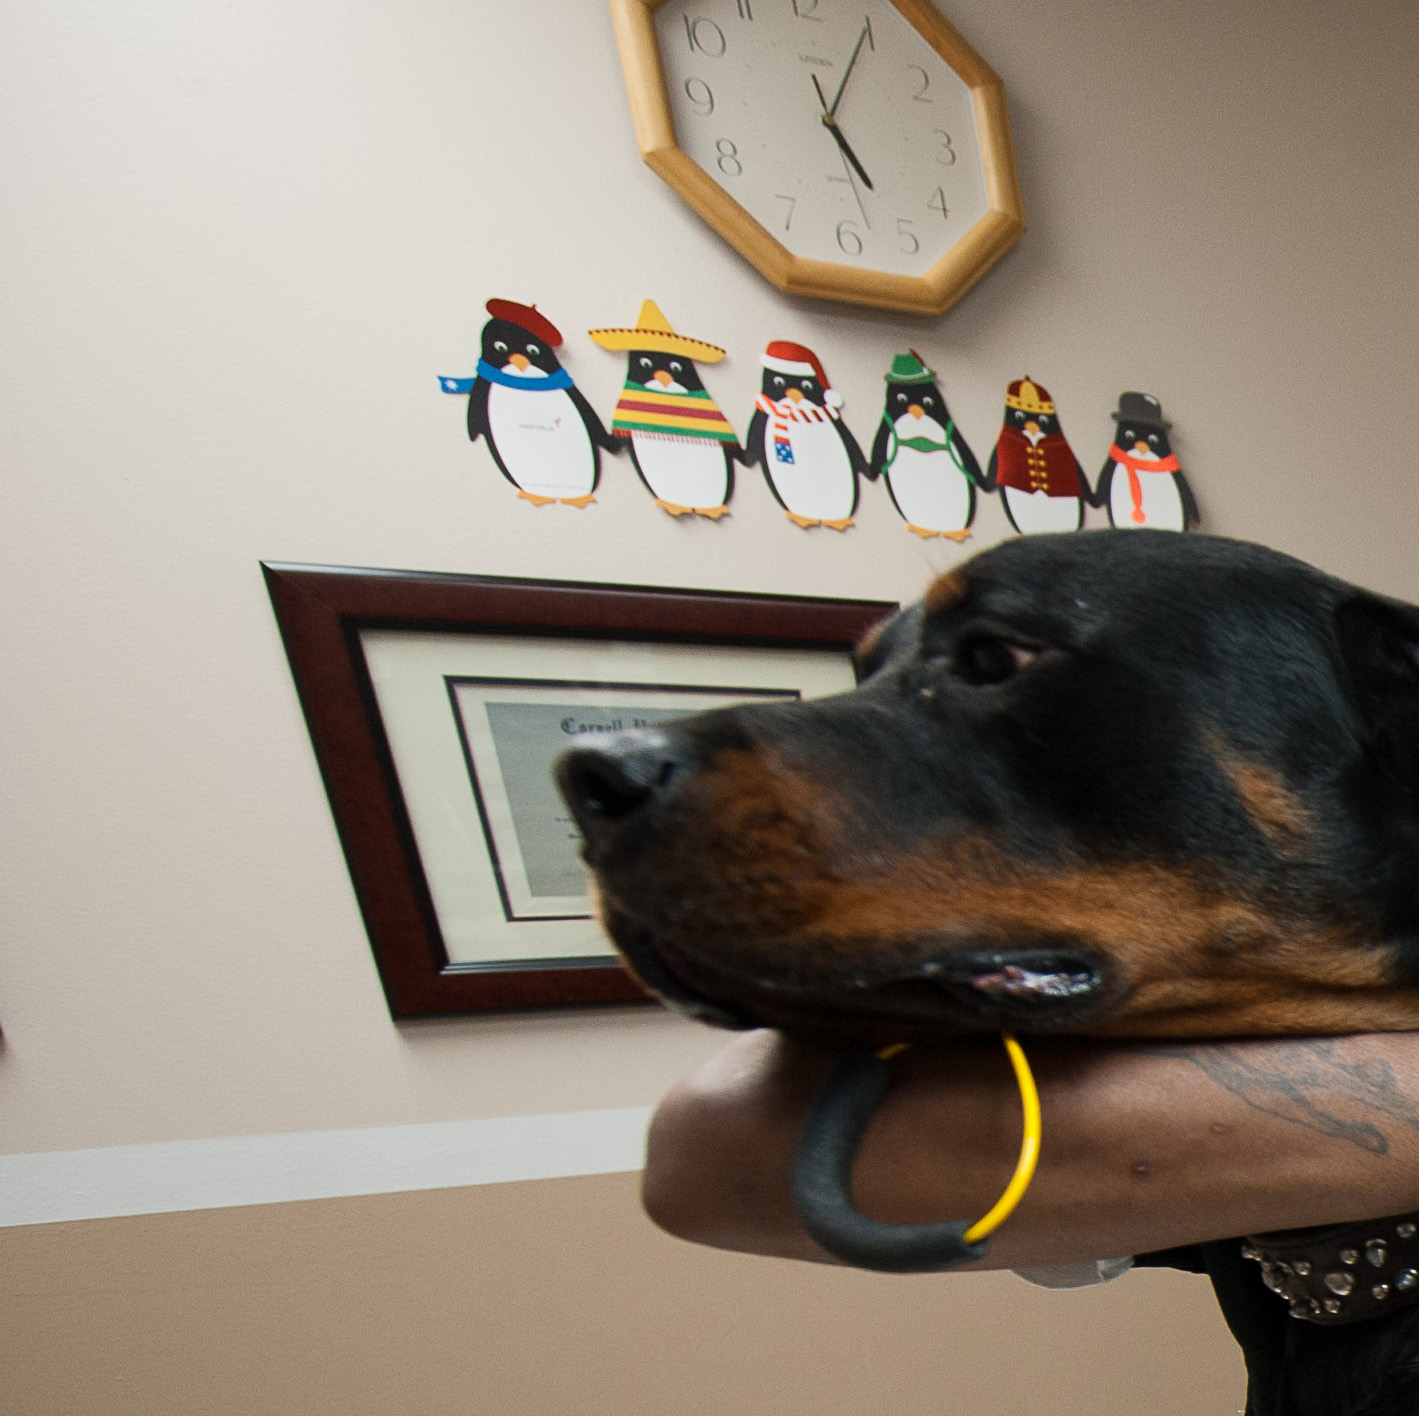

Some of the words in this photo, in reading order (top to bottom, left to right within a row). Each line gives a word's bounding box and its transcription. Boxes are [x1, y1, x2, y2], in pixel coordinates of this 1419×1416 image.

[683, 13, 726, 58] 10
[865, 14, 874, 51] 1
[684, 77, 714, 117] 9
[908, 63, 933, 103] 2
[715, 138, 742, 177] 8
[932, 129, 956, 166] 3
[774, 194, 796, 231] 7
[926, 186, 948, 219] 4
[836, 219, 862, 256] 6
[896, 218, 919, 253] 5
